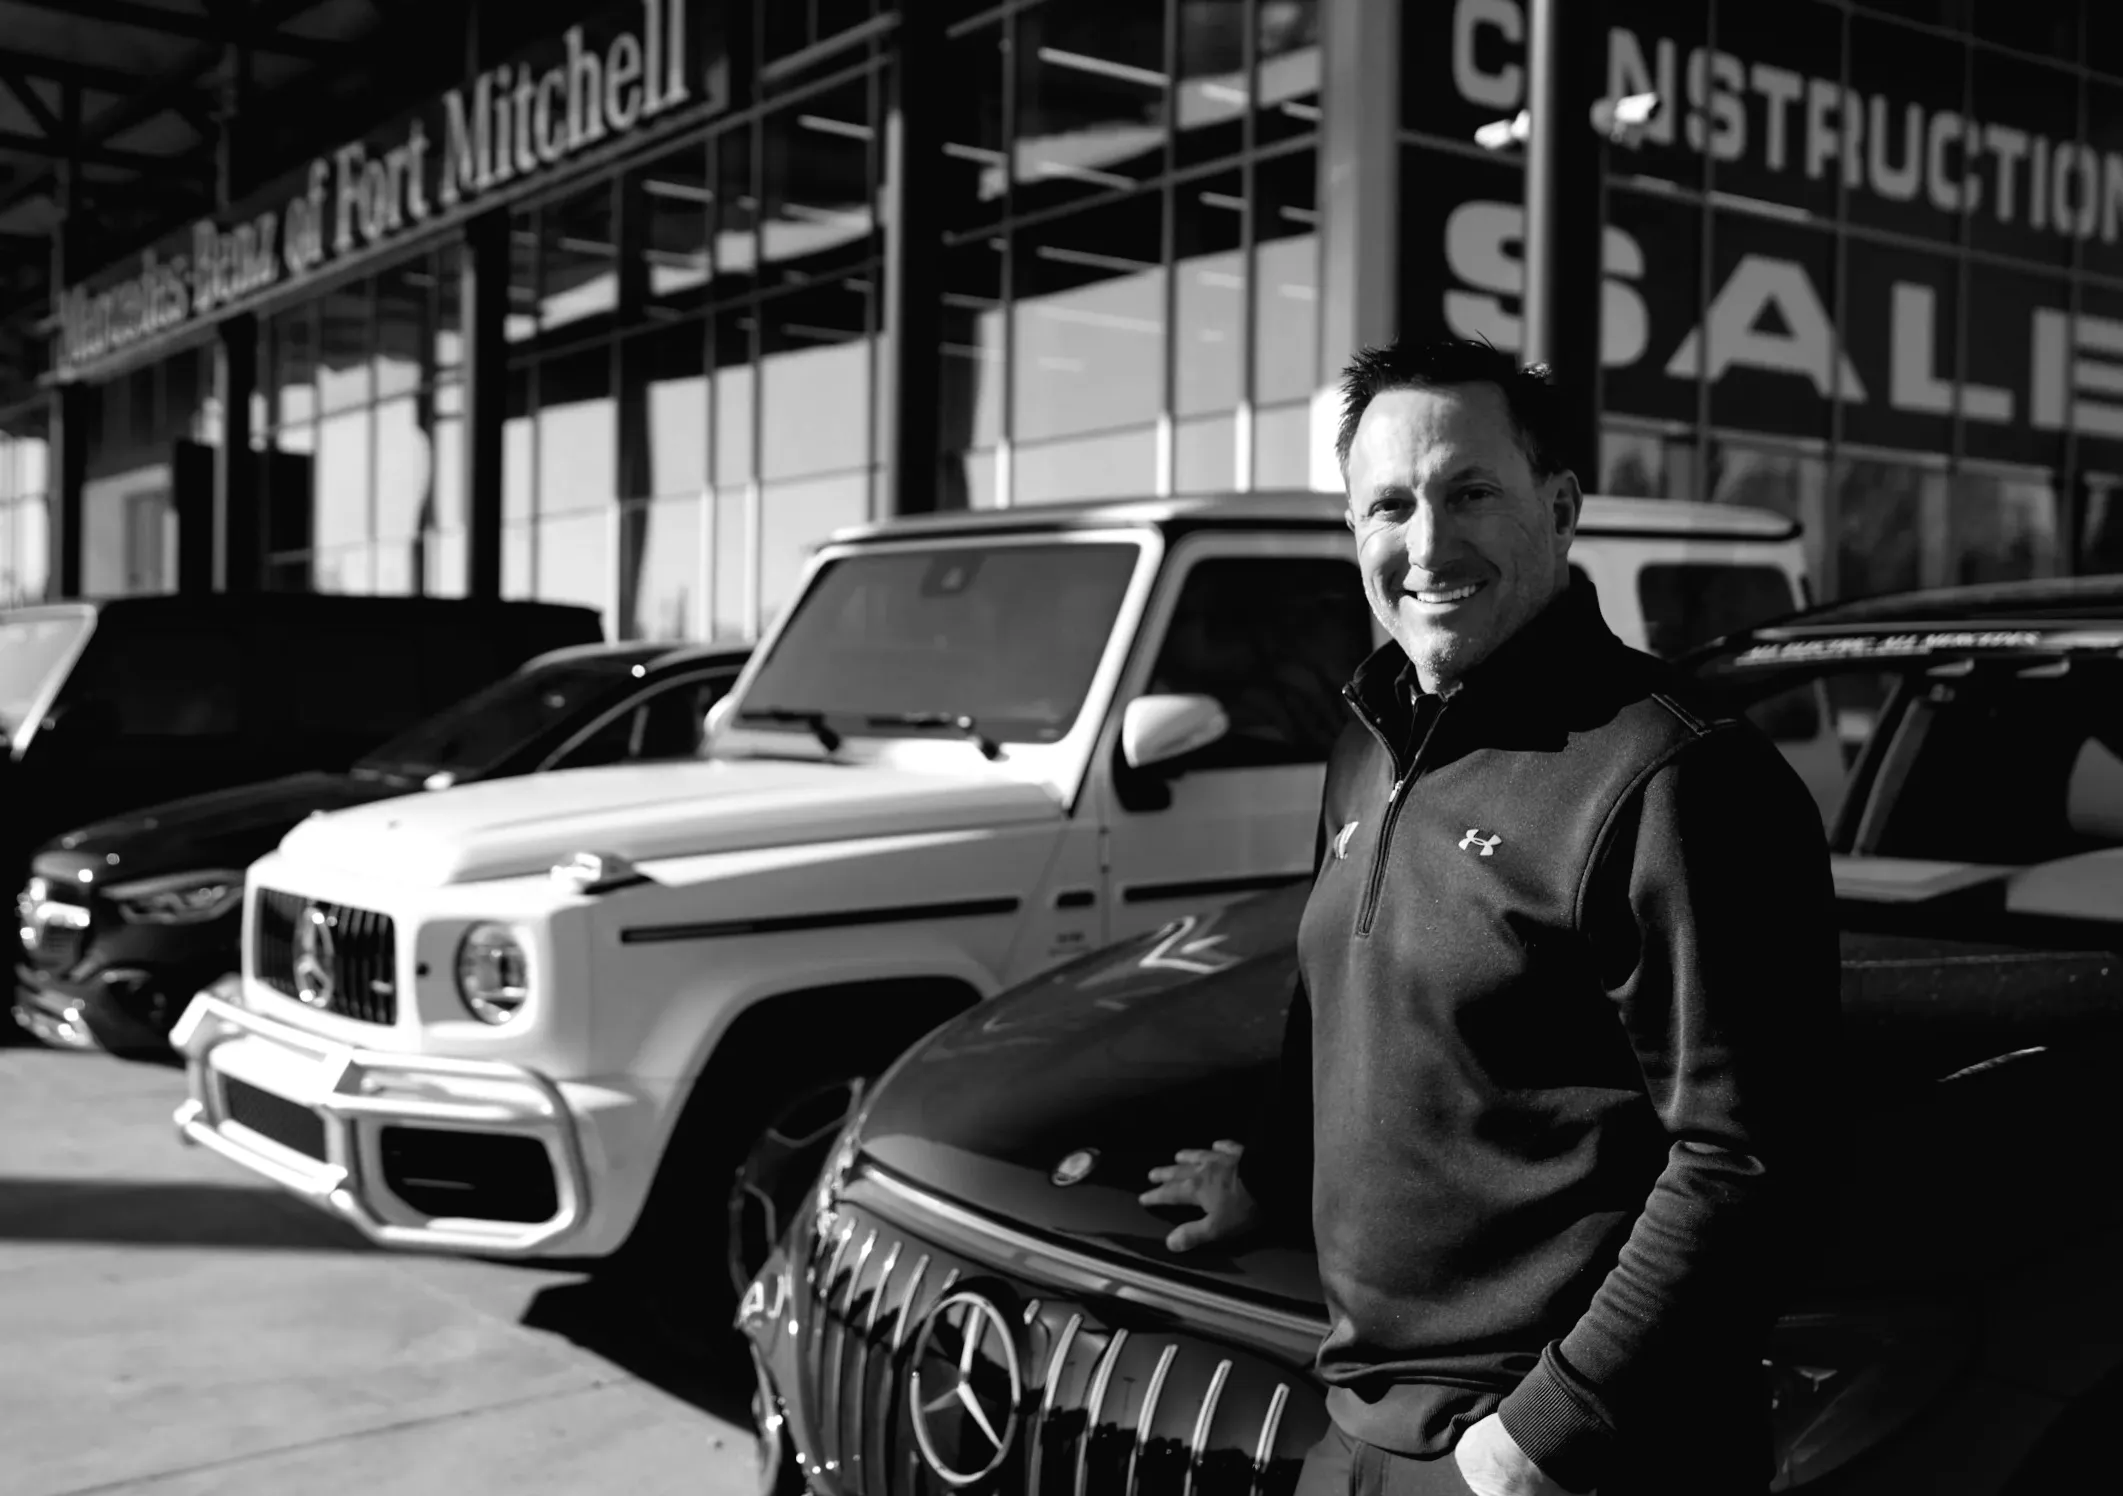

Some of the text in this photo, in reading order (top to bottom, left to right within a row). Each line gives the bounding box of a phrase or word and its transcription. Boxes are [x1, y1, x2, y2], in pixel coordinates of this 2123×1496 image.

[285, 157, 329, 275] of
[335, 118, 429, 252] Fort
[441, 0, 687, 203] Mitchell
[1451, 0, 2123, 243] CNSTRUCTIO
[1444, 200, 2123, 440] SALE
